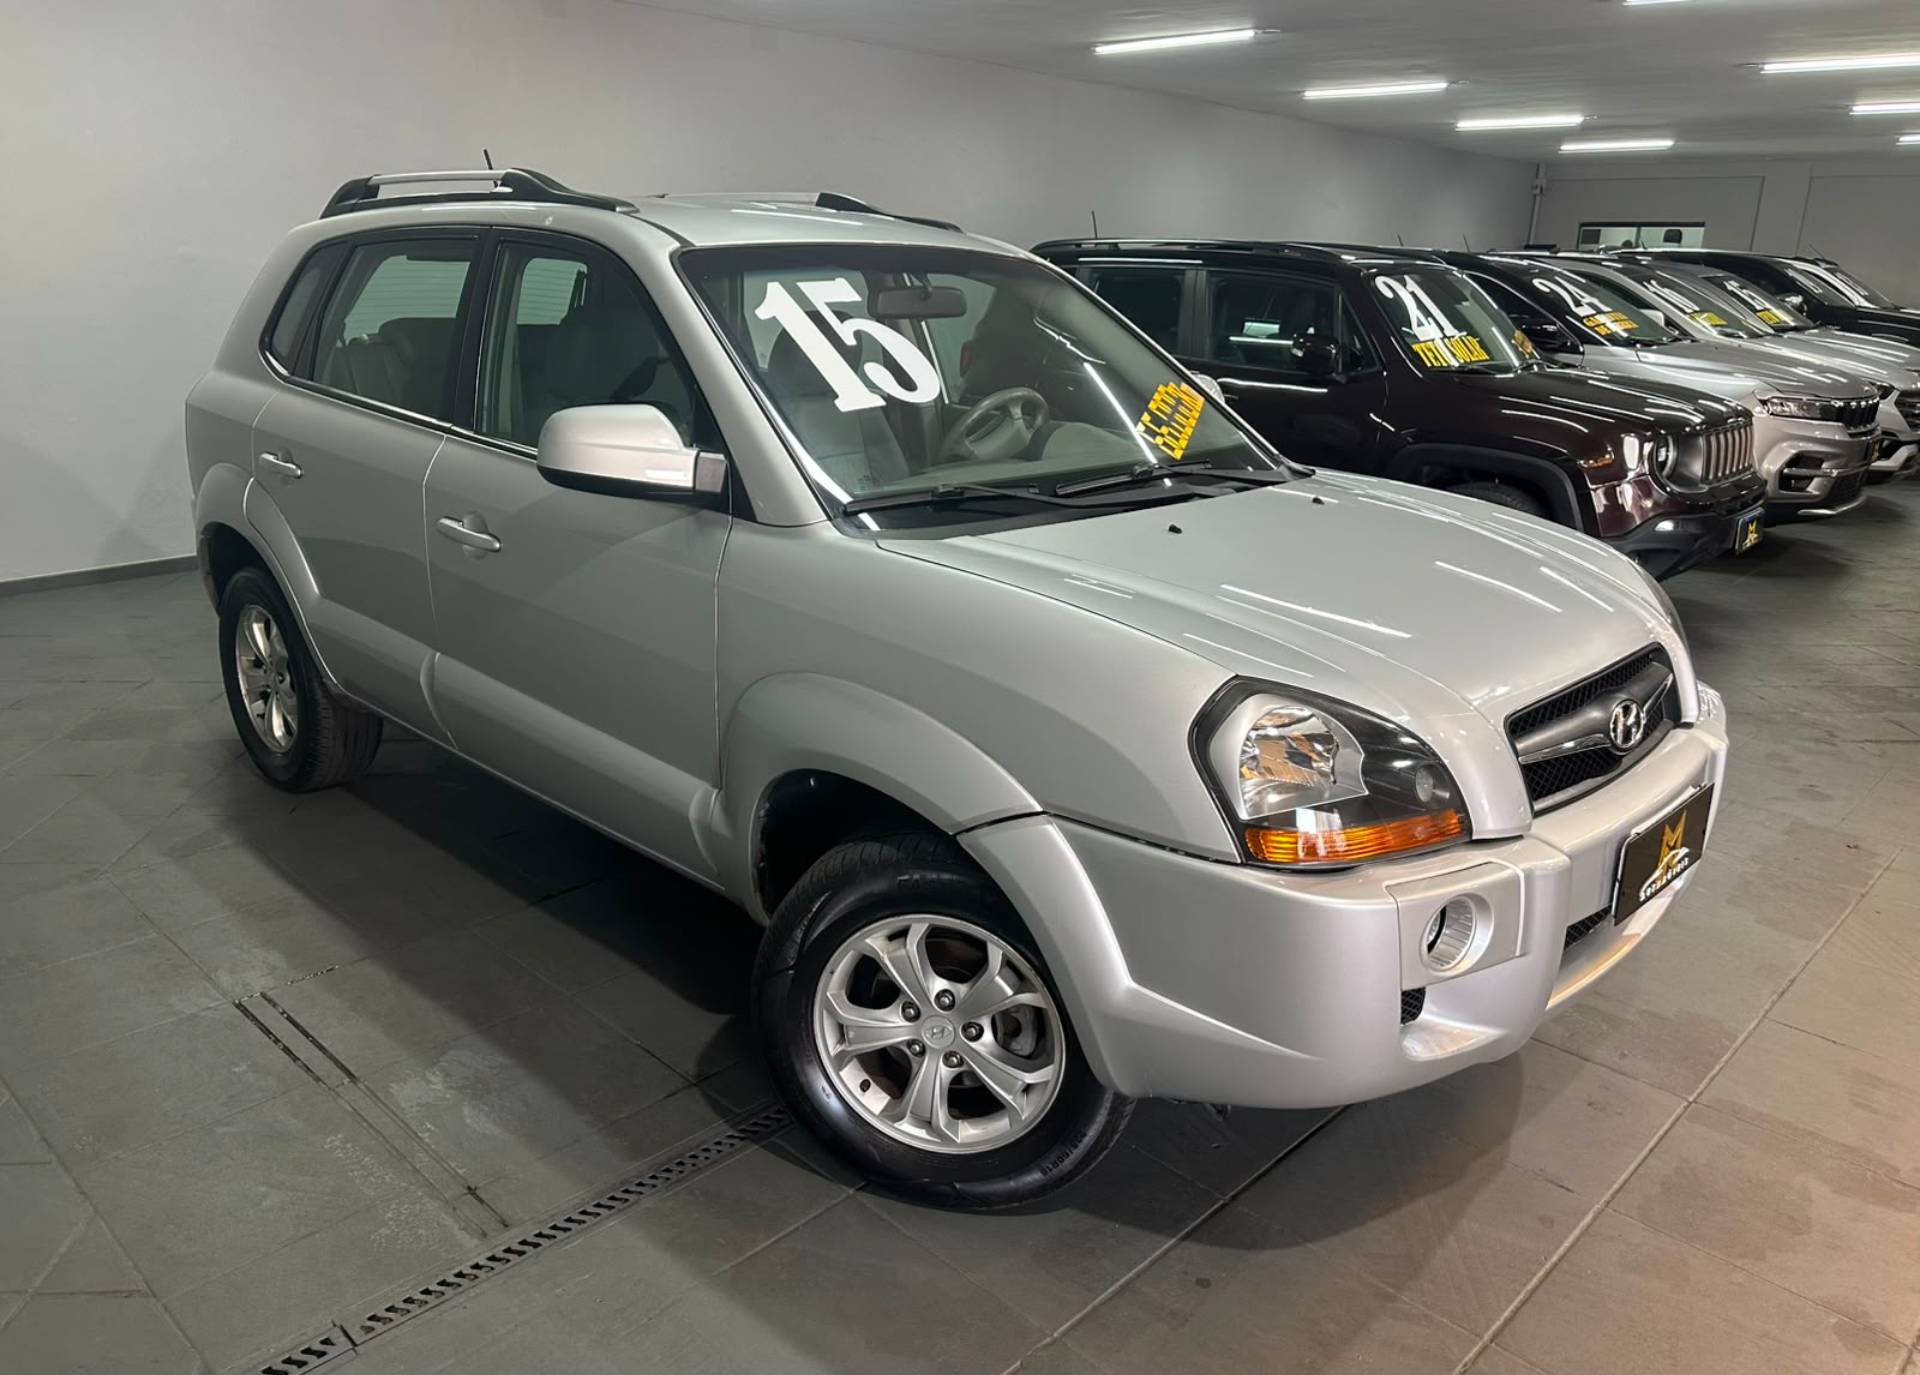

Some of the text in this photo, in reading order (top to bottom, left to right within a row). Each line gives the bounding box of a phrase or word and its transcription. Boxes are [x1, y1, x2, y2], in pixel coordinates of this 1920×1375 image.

[1375, 275, 1467, 341] 21
[1532, 276, 1613, 317] 24
[755, 277, 941, 412] 15
